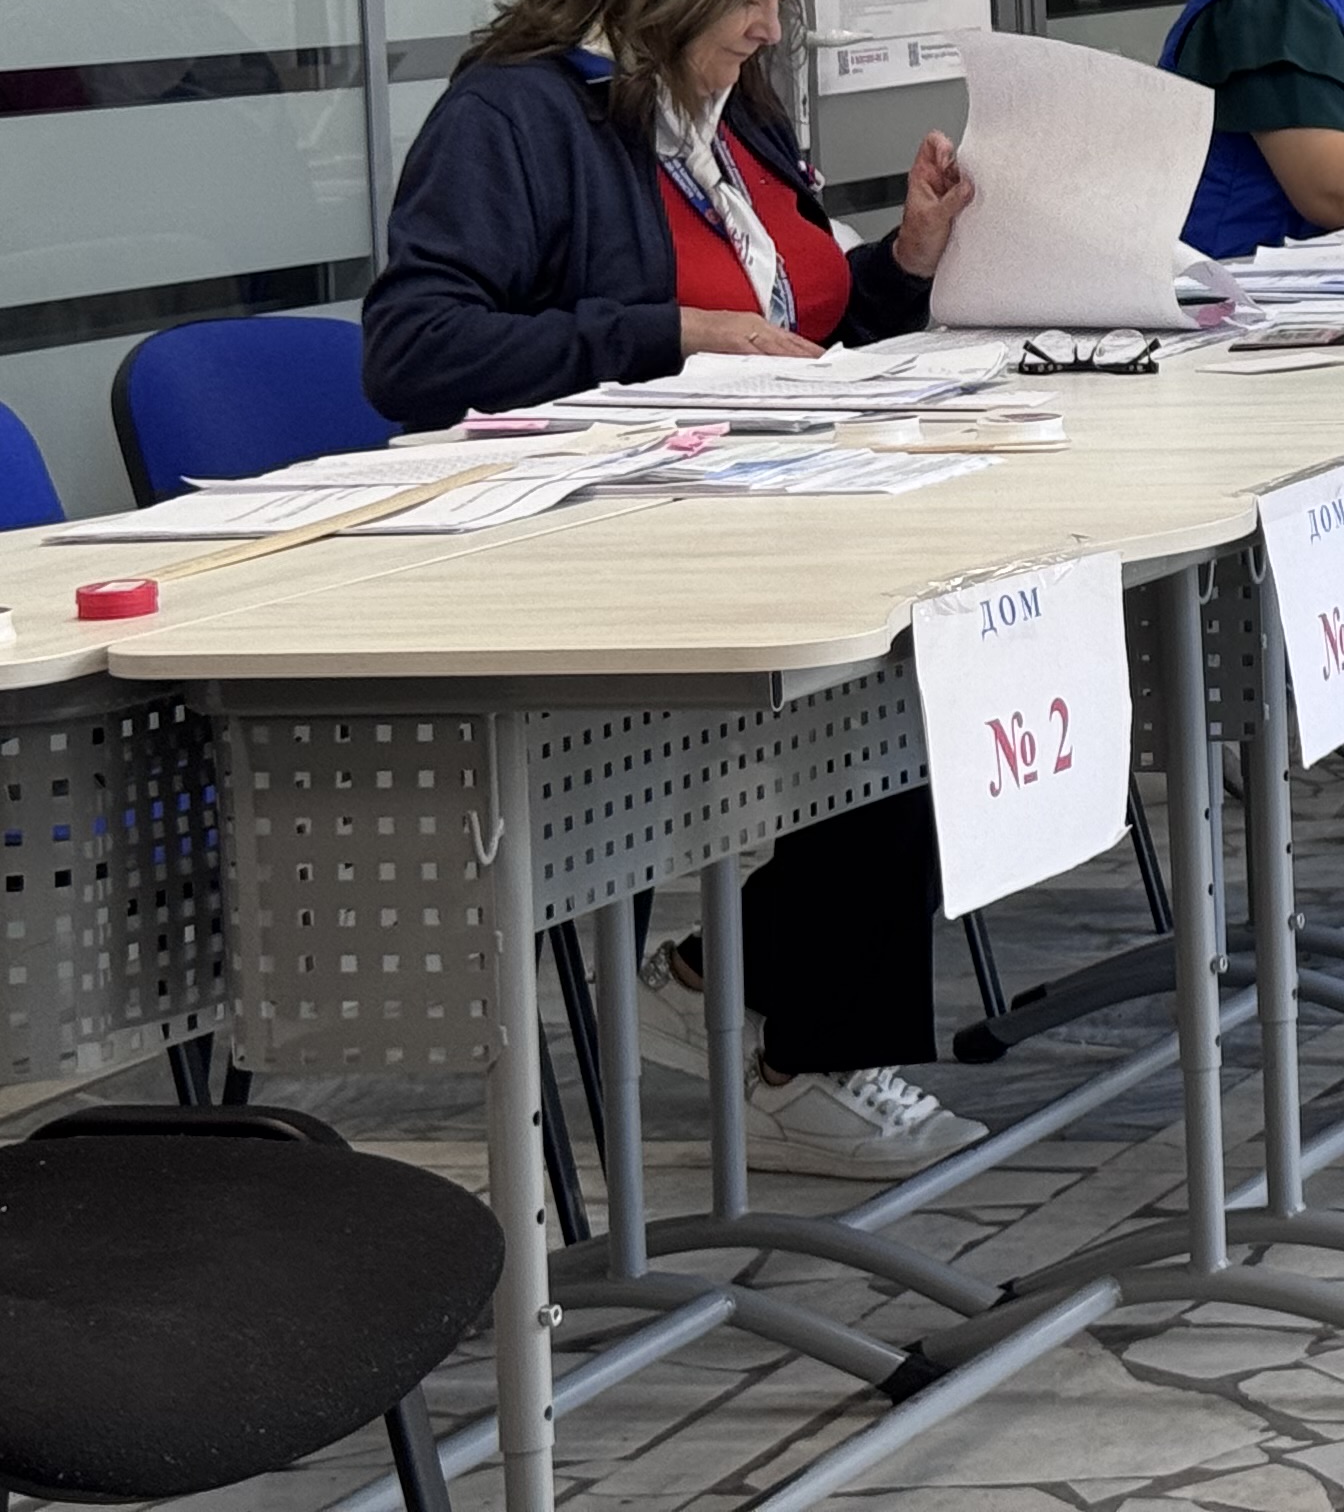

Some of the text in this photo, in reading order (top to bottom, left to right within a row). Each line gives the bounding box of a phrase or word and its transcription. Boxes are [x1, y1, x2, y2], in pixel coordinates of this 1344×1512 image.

[979, 586, 1042, 642] ДОМ
[984, 696, 1073, 798] № 2
